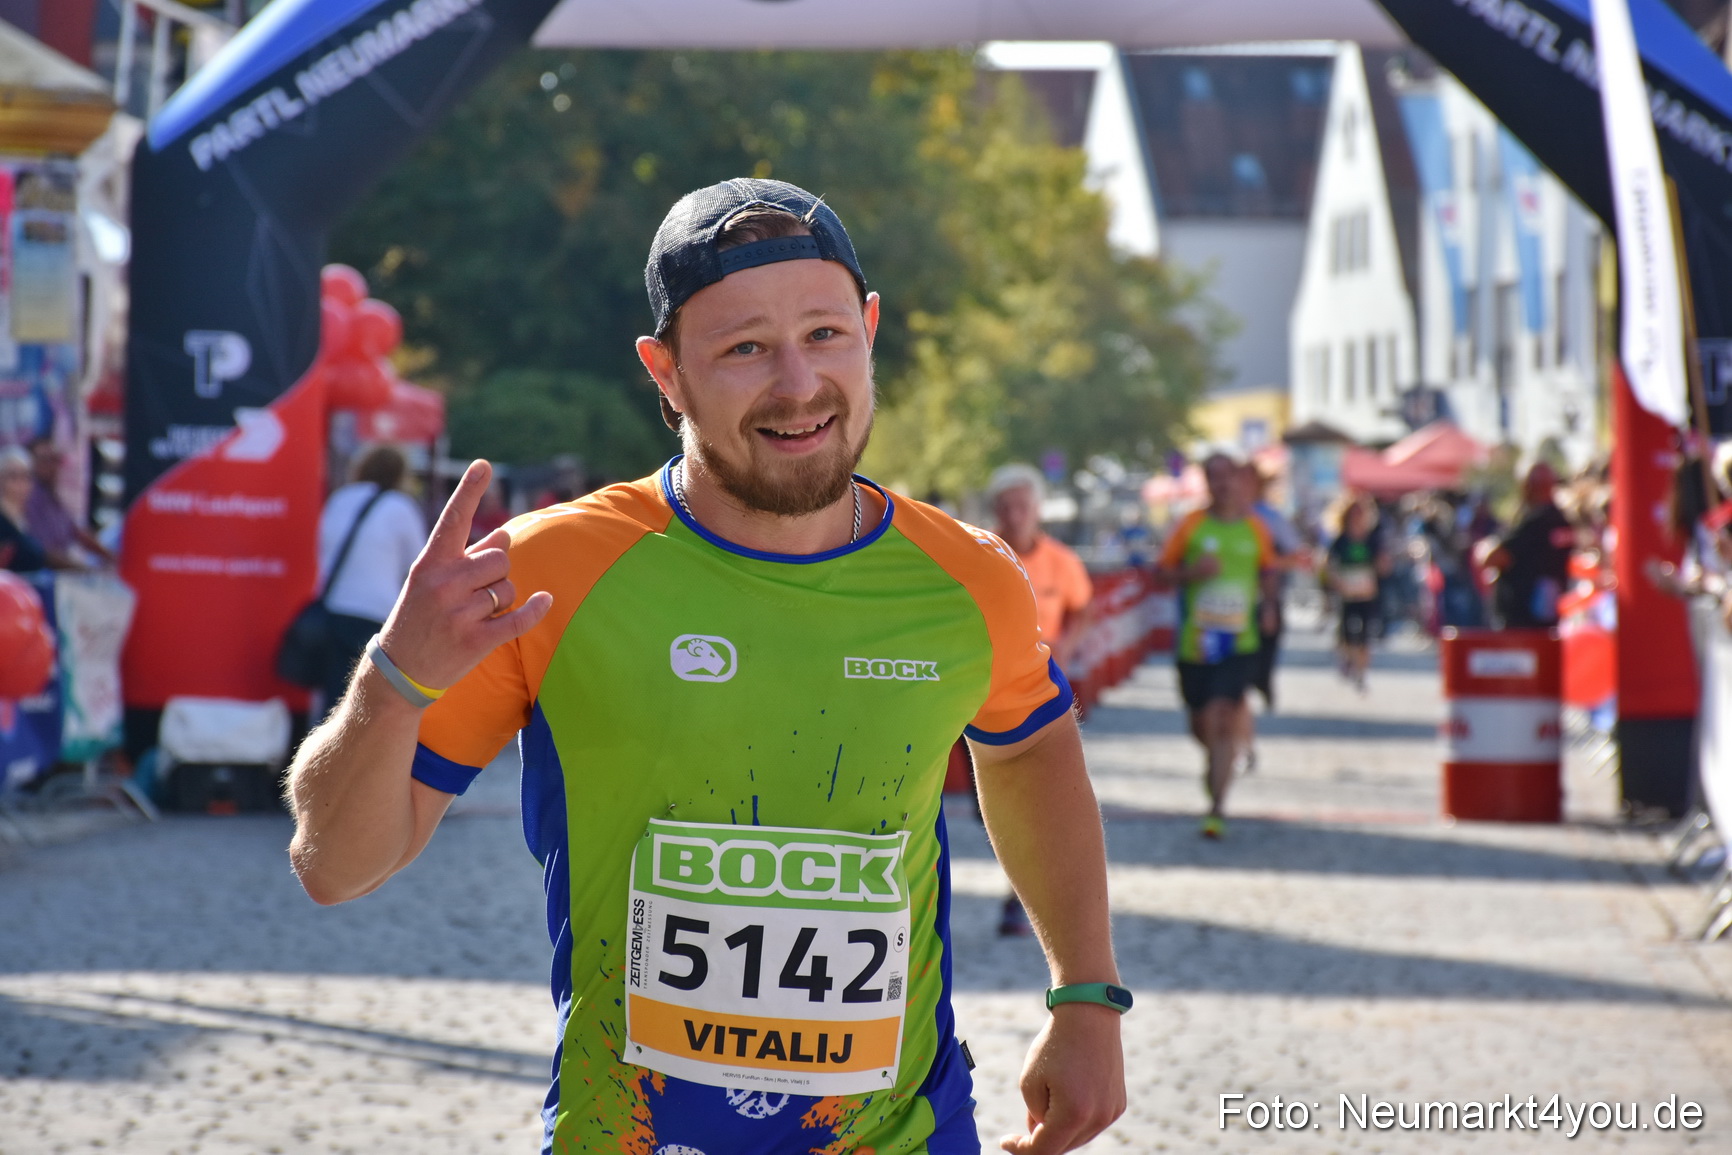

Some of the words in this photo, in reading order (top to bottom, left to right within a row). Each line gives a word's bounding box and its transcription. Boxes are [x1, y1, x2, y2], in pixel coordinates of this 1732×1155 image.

[190, 86, 305, 171] PARTL
[294, 0, 484, 105] NEUMARK
[844, 657, 940, 681] BOCK
[654, 835, 900, 901] BOCK
[658, 914, 888, 1004] 5142
[896, 932, 904, 947] S
[683, 1019, 853, 1065] VITALIJ
